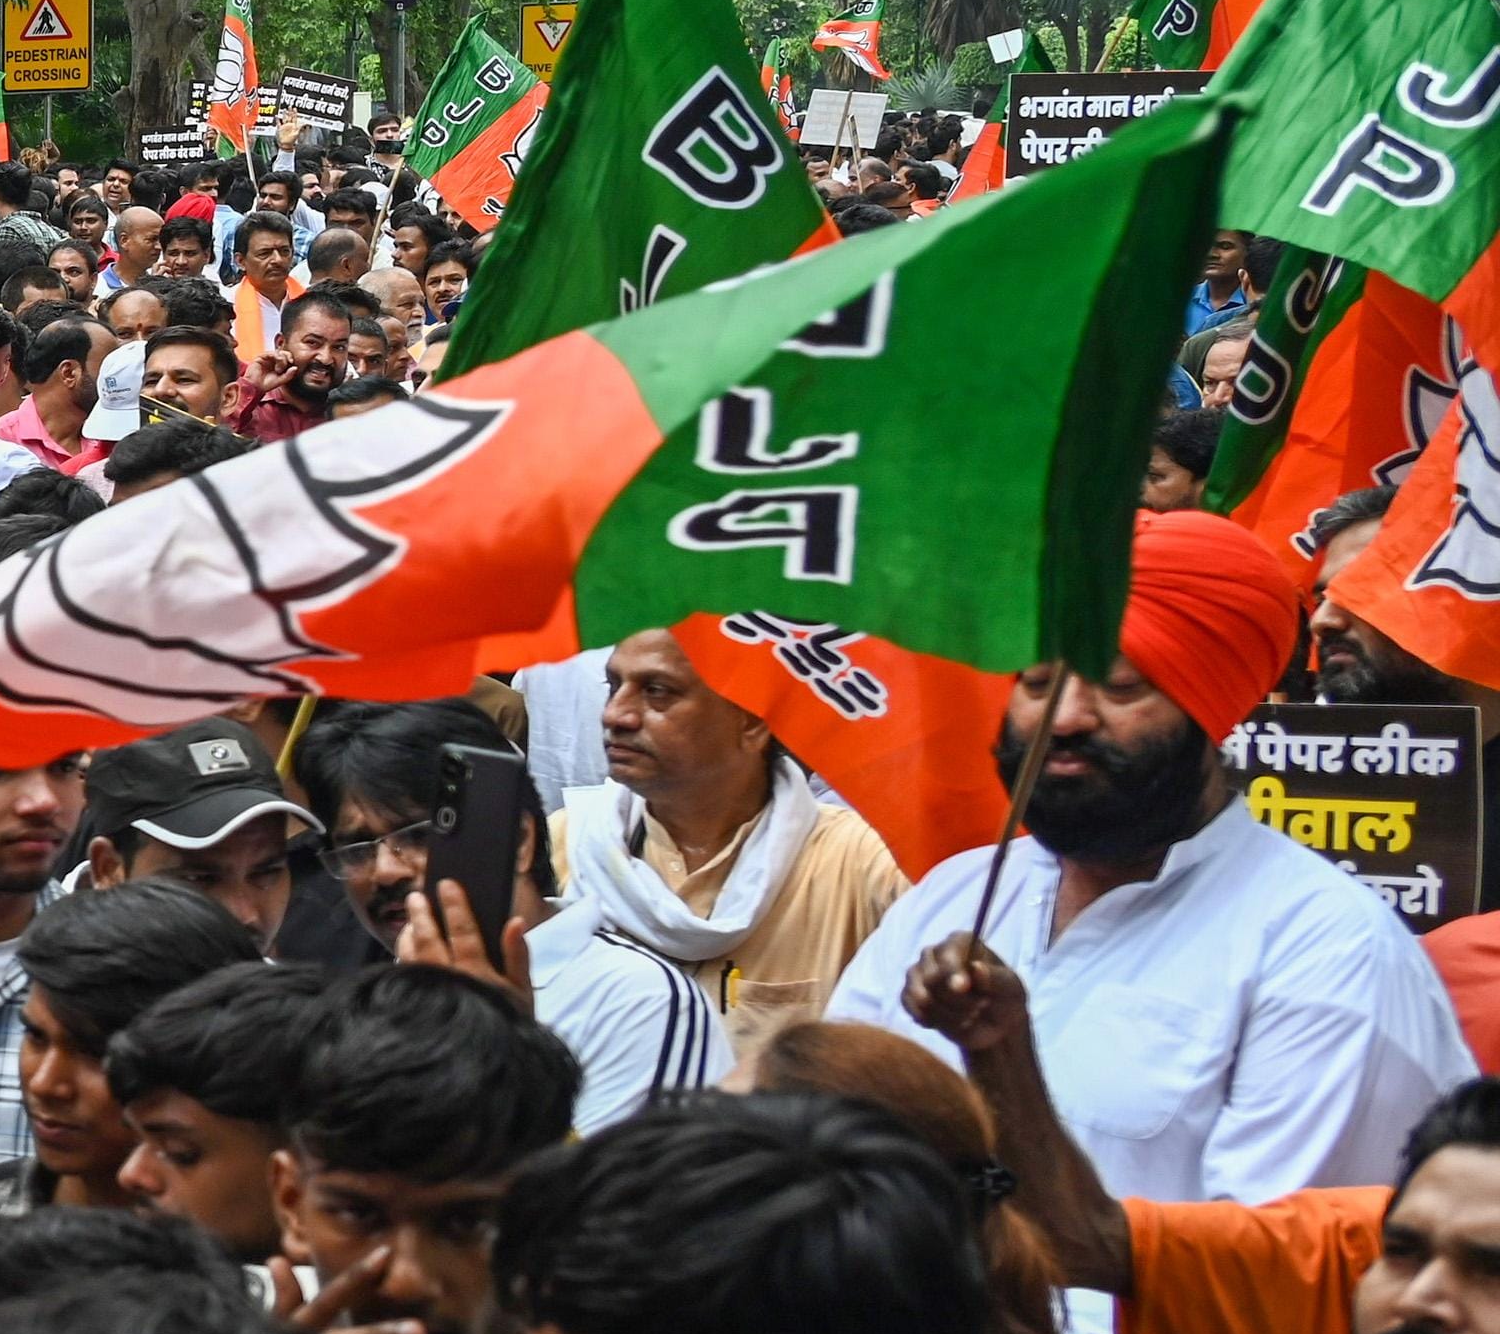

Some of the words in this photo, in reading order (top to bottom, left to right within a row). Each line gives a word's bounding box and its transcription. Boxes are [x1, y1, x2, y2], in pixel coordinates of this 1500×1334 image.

[6, 47, 87, 63] PEDESTRIAN
[13, 68, 81, 82] CROSSING
[1019, 88, 1085, 118] भगवंत
[1086, 94, 1131, 118] मान
[1019, 129, 1069, 164] पेपर
[1255, 721, 1346, 774] पेपर
[1349, 723, 1459, 776] लीक
